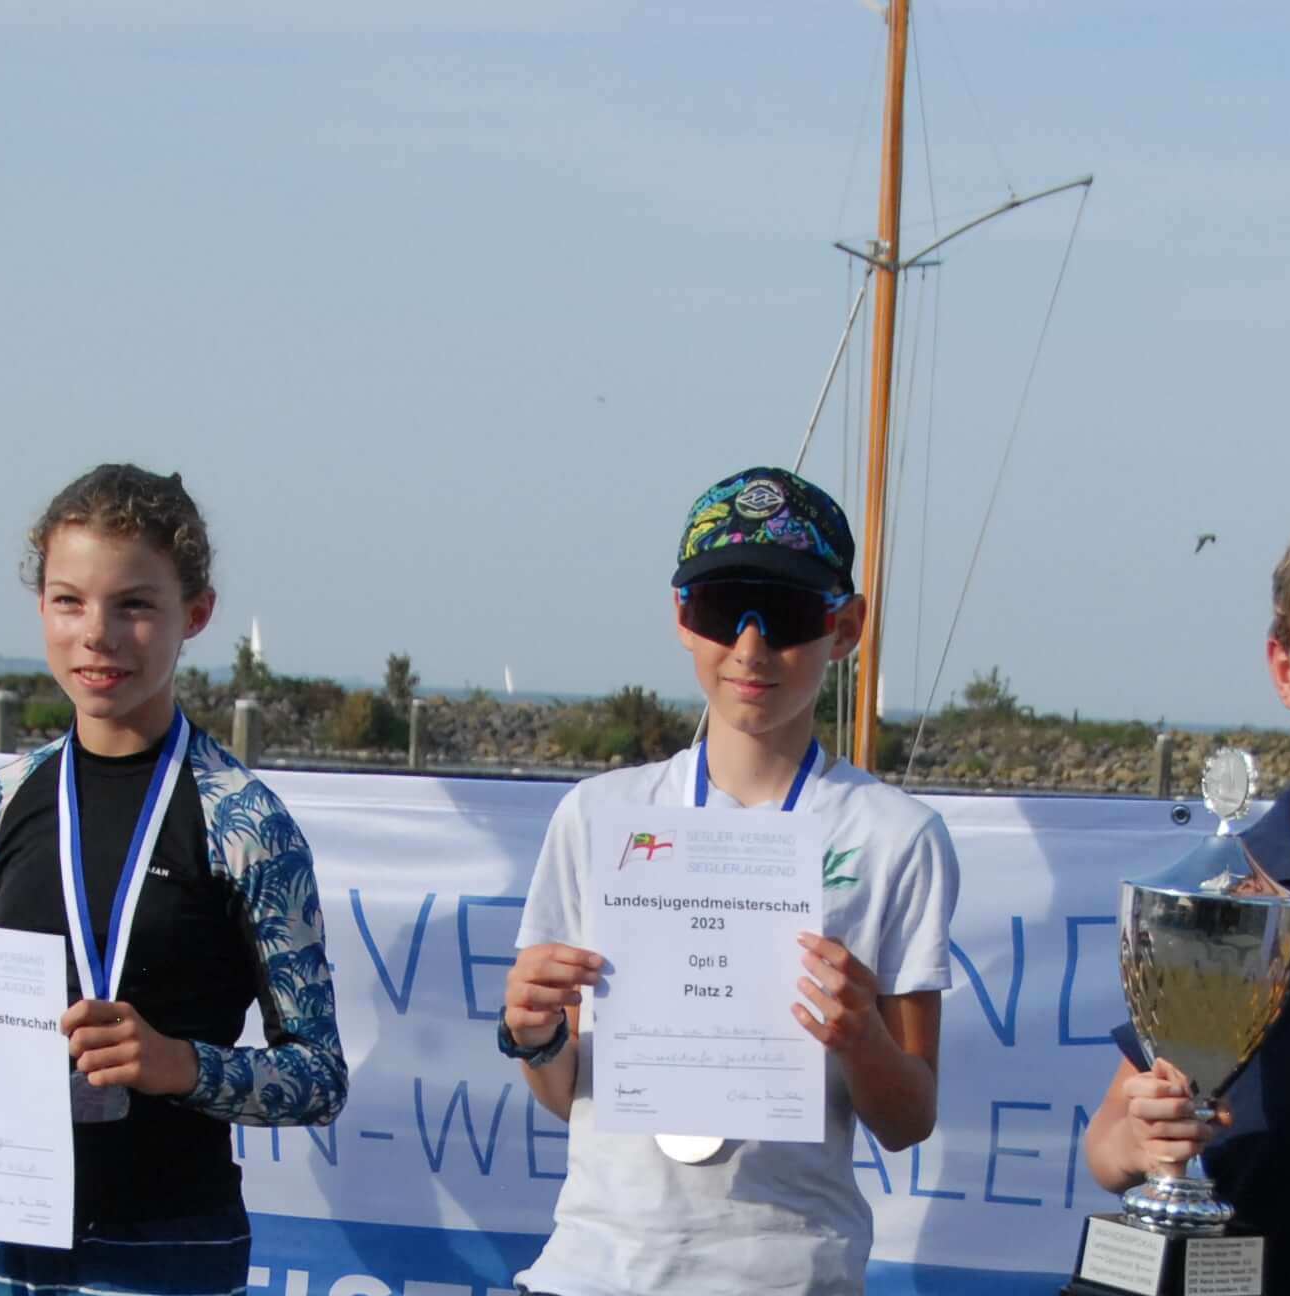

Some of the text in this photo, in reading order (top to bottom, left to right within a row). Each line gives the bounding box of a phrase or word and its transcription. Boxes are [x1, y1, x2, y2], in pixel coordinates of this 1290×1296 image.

[604, 894, 810, 914] Landesjugendmeisterschaft
[691, 917, 725, 930] 2023
[688, 955, 728, 970] Opti B
[684, 984, 733, 998] Platz 2
